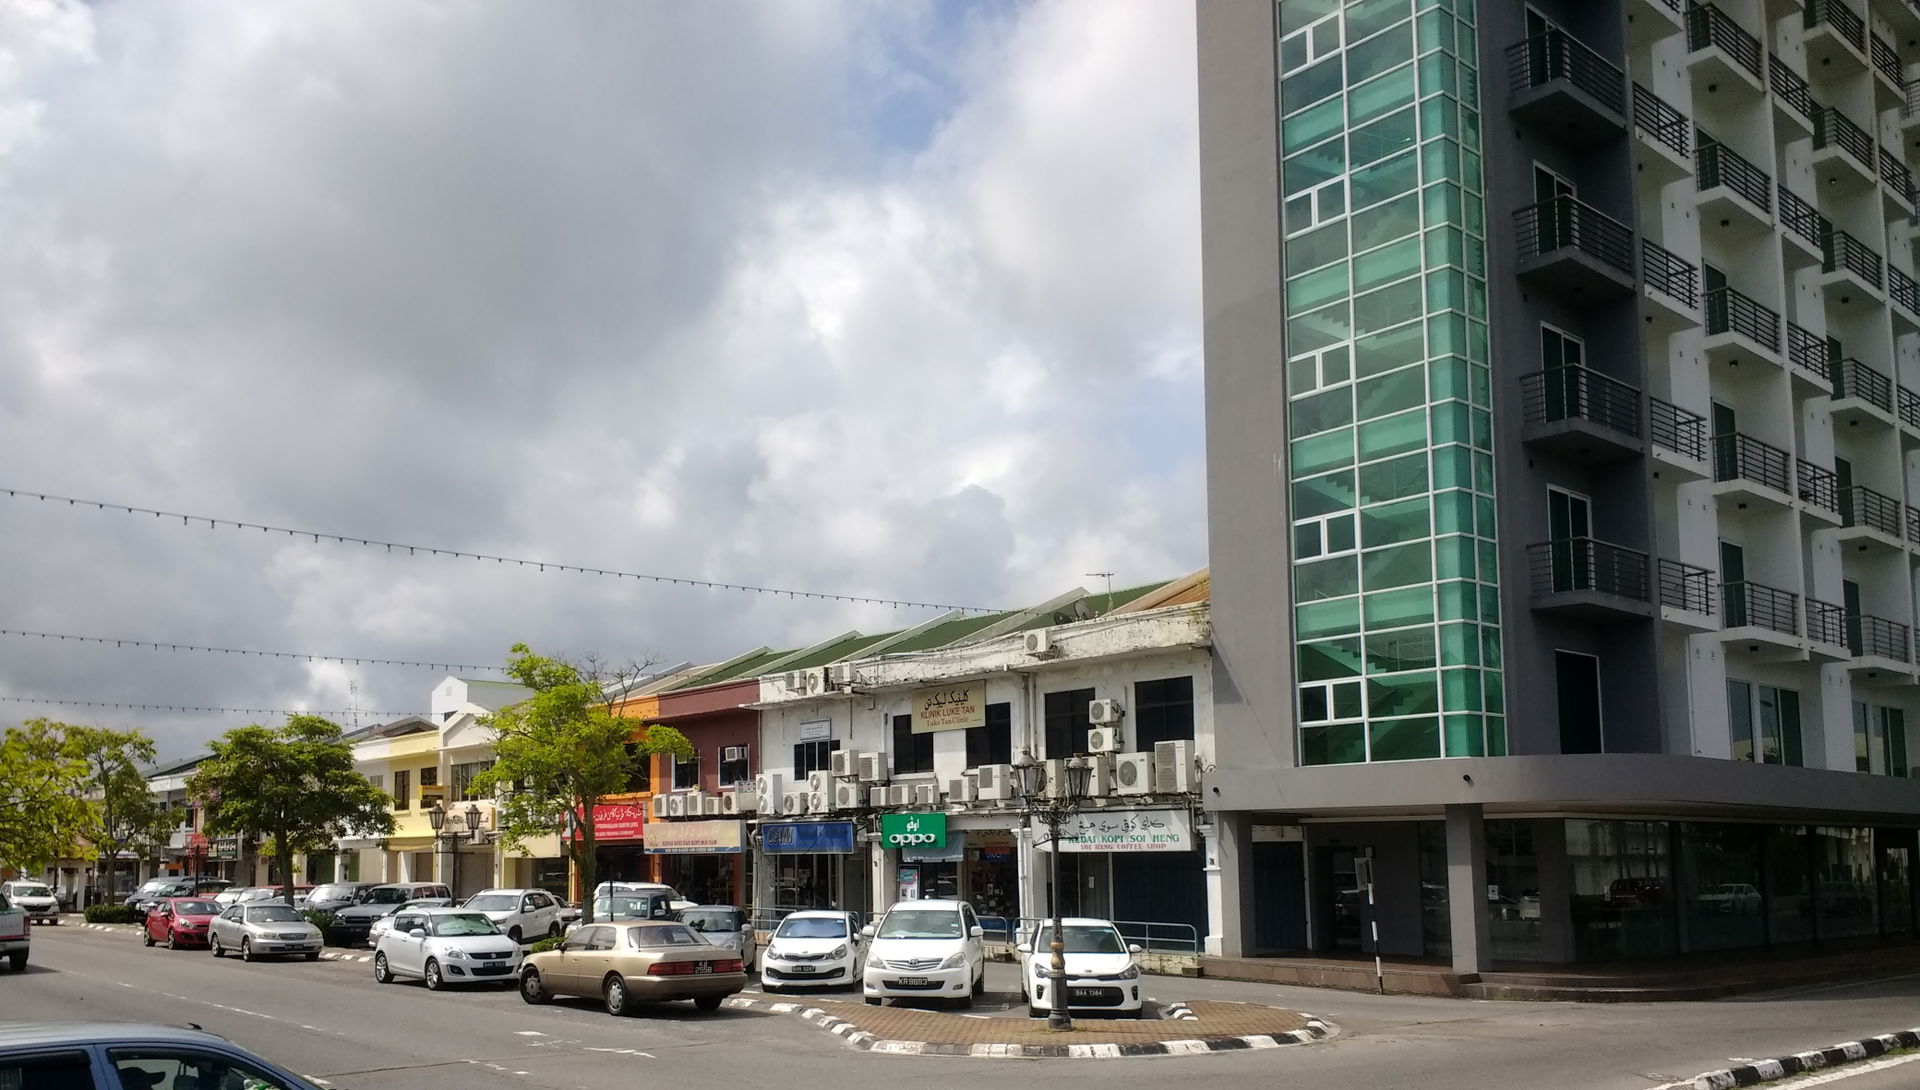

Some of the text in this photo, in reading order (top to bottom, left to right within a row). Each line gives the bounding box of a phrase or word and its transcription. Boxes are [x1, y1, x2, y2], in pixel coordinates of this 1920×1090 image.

[920, 705, 975, 719] KLINIK LUKE TAN
[889, 833, 936, 846] oppo
[1101, 835, 1124, 843] KOPI
[1130, 834, 1146, 843] SOI
[1152, 834, 1180, 842] HENG
